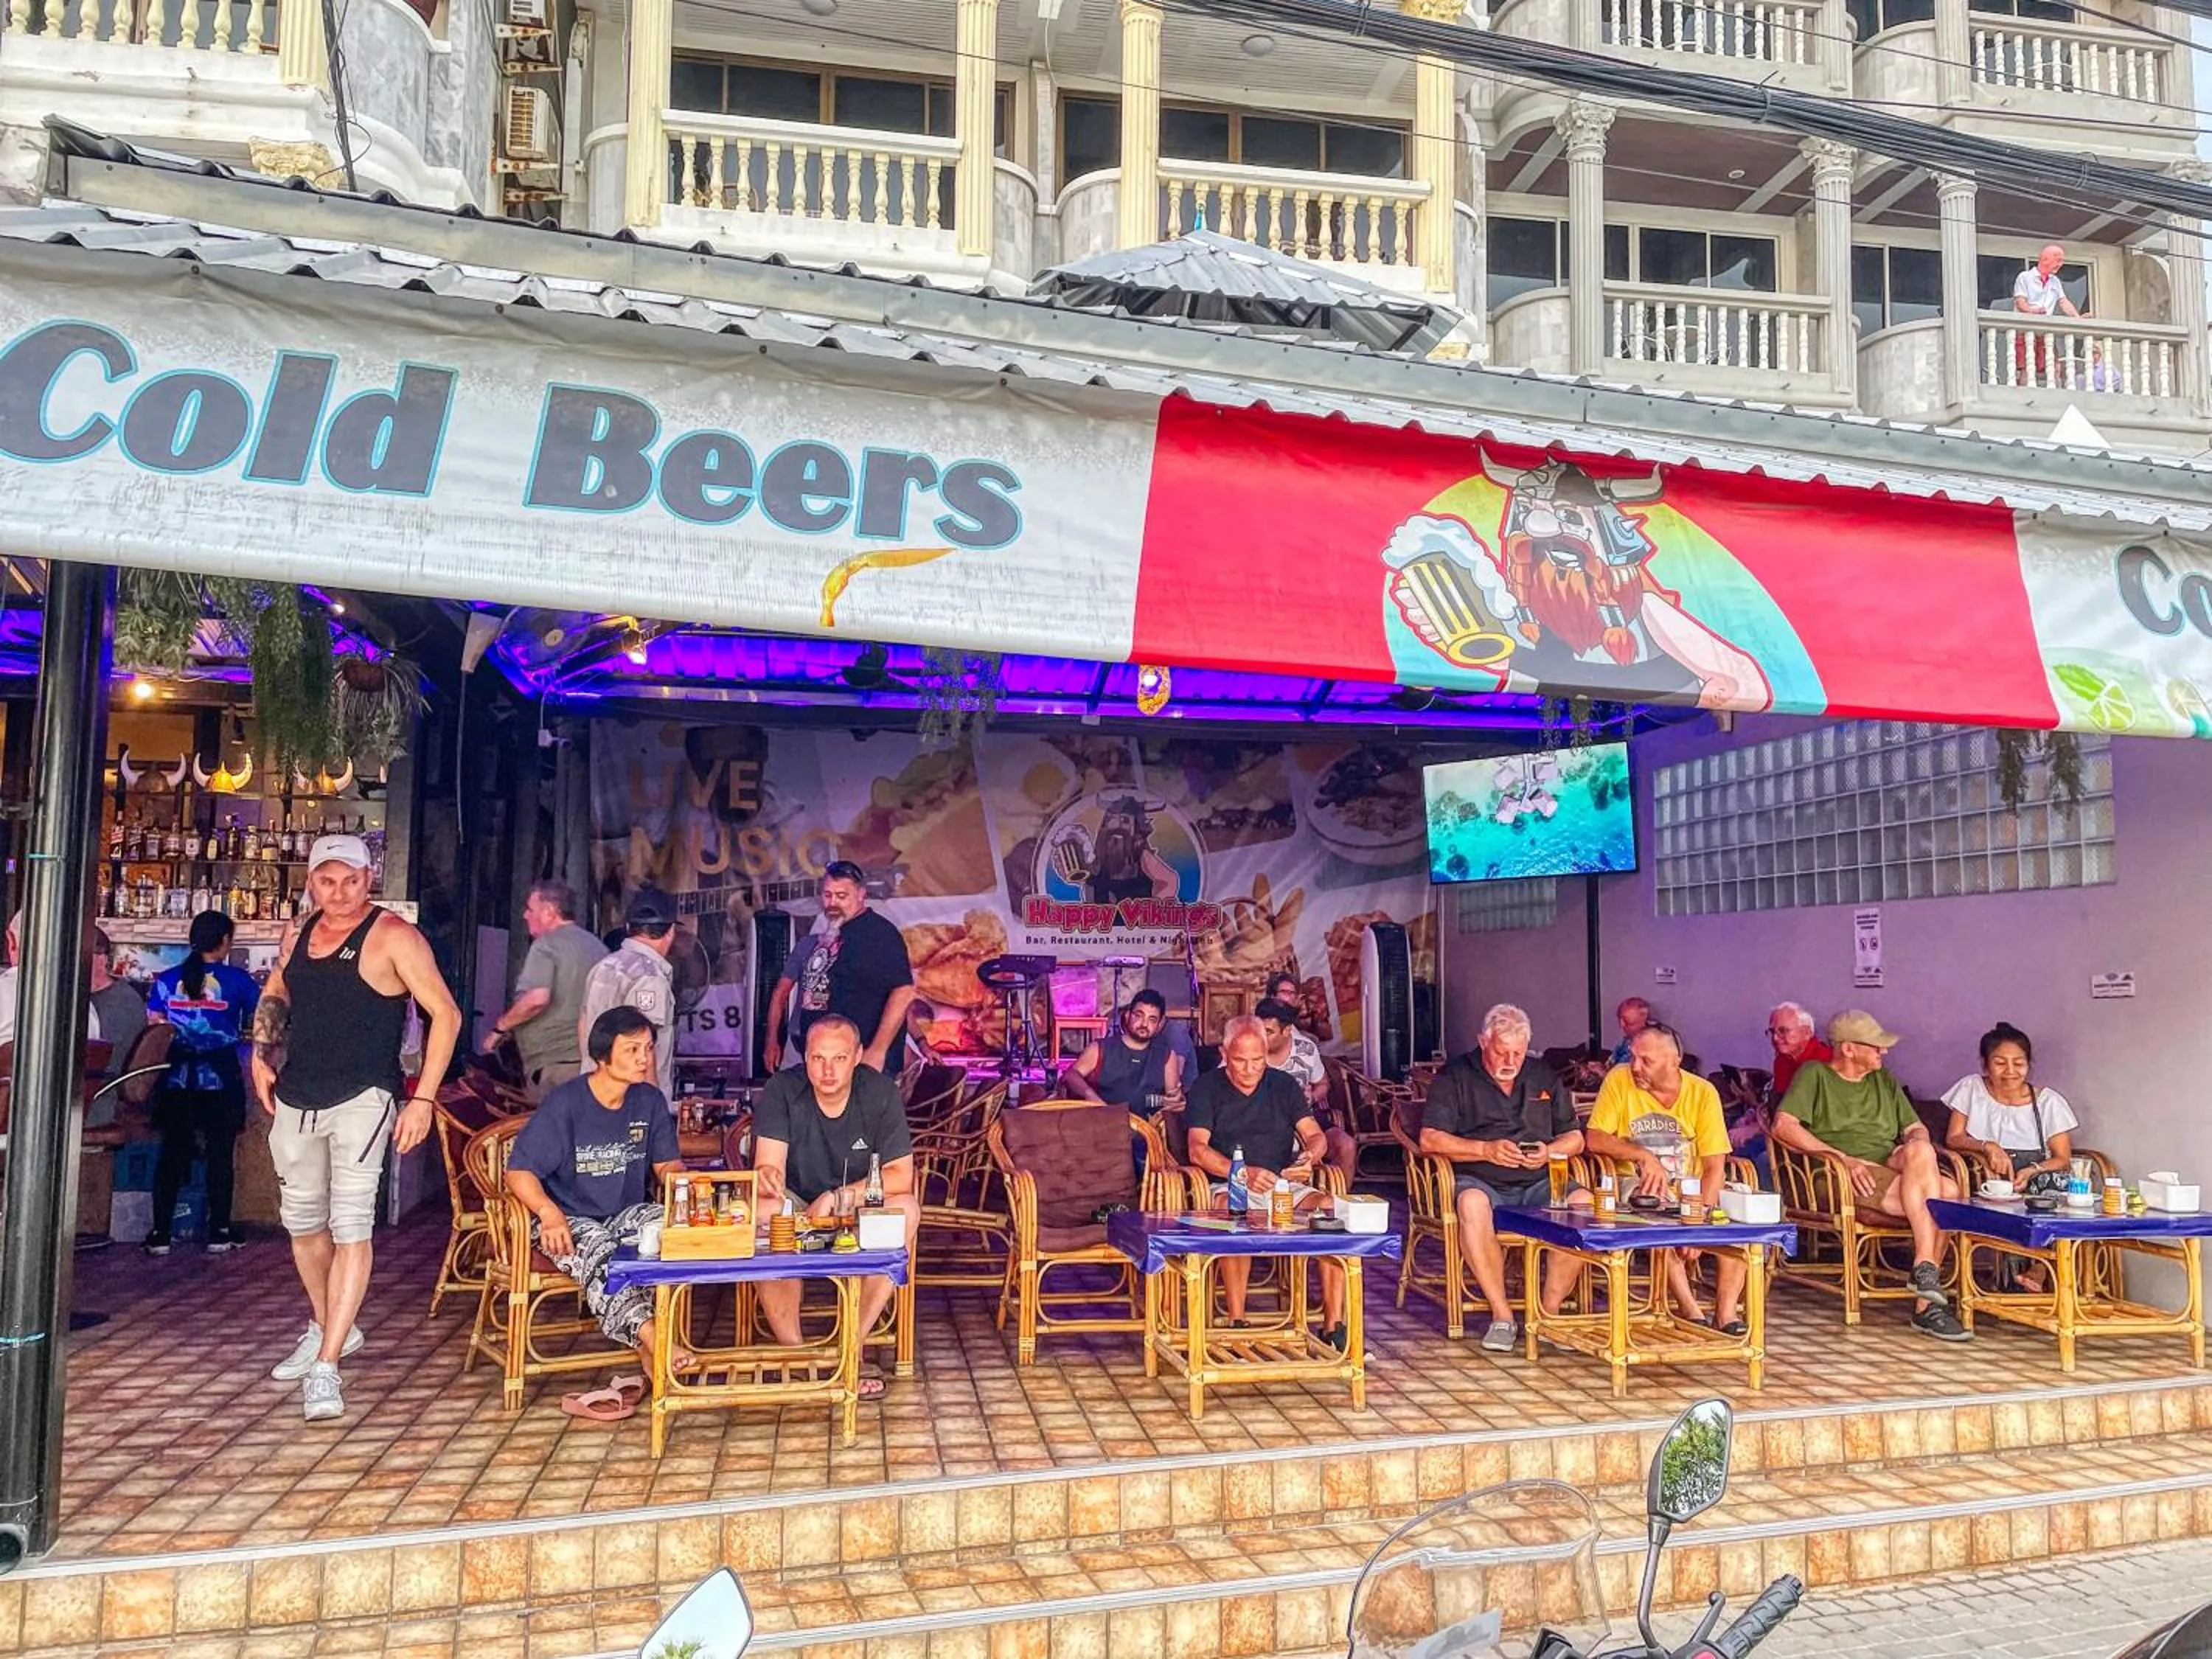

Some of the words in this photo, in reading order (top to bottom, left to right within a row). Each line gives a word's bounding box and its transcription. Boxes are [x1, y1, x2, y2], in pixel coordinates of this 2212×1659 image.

[0, 319, 459, 497] Cold
[522, 381, 1023, 550] Beers
[628, 759, 759, 810] LIVE
[629, 825, 843, 878] MUSIC
[1024, 895, 1116, 933] Happy
[1117, 897, 1222, 933] Vikings
[1026, 936, 1046, 945] Bar,
[1051, 936, 1113, 945] Restaurant,
[1117, 936, 1145, 944] Hotel
[1149, 936, 1155, 944] &
[724, 1006, 741, 1029] 8
